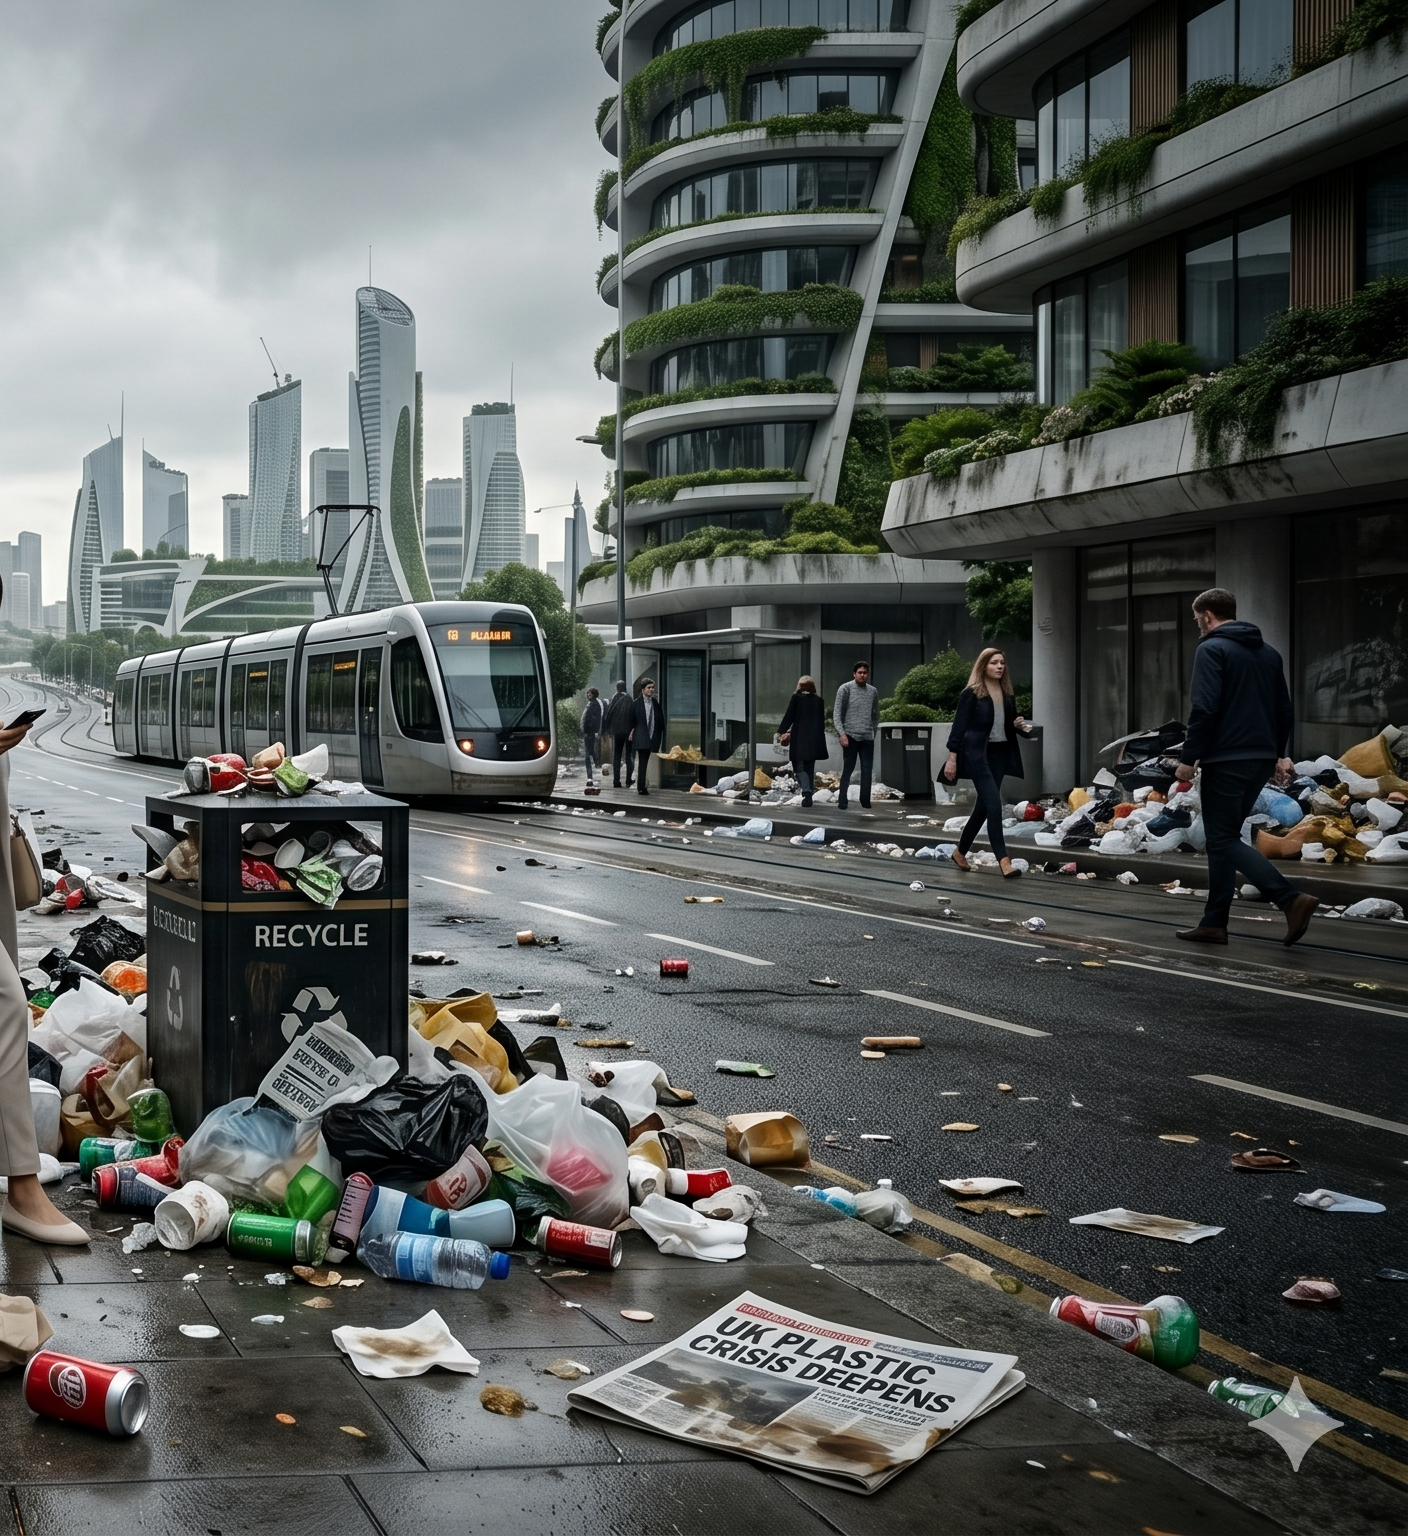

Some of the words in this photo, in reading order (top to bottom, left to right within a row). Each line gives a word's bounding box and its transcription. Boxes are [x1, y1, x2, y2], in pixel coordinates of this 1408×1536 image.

[255, 923, 369, 948] RECYCLE
[689, 1334, 797, 1381] CRISIS
[795, 1362, 956, 1414] DEEPENS
[715, 1316, 778, 1344] UK
[771, 1332, 936, 1386] PLASTIC
